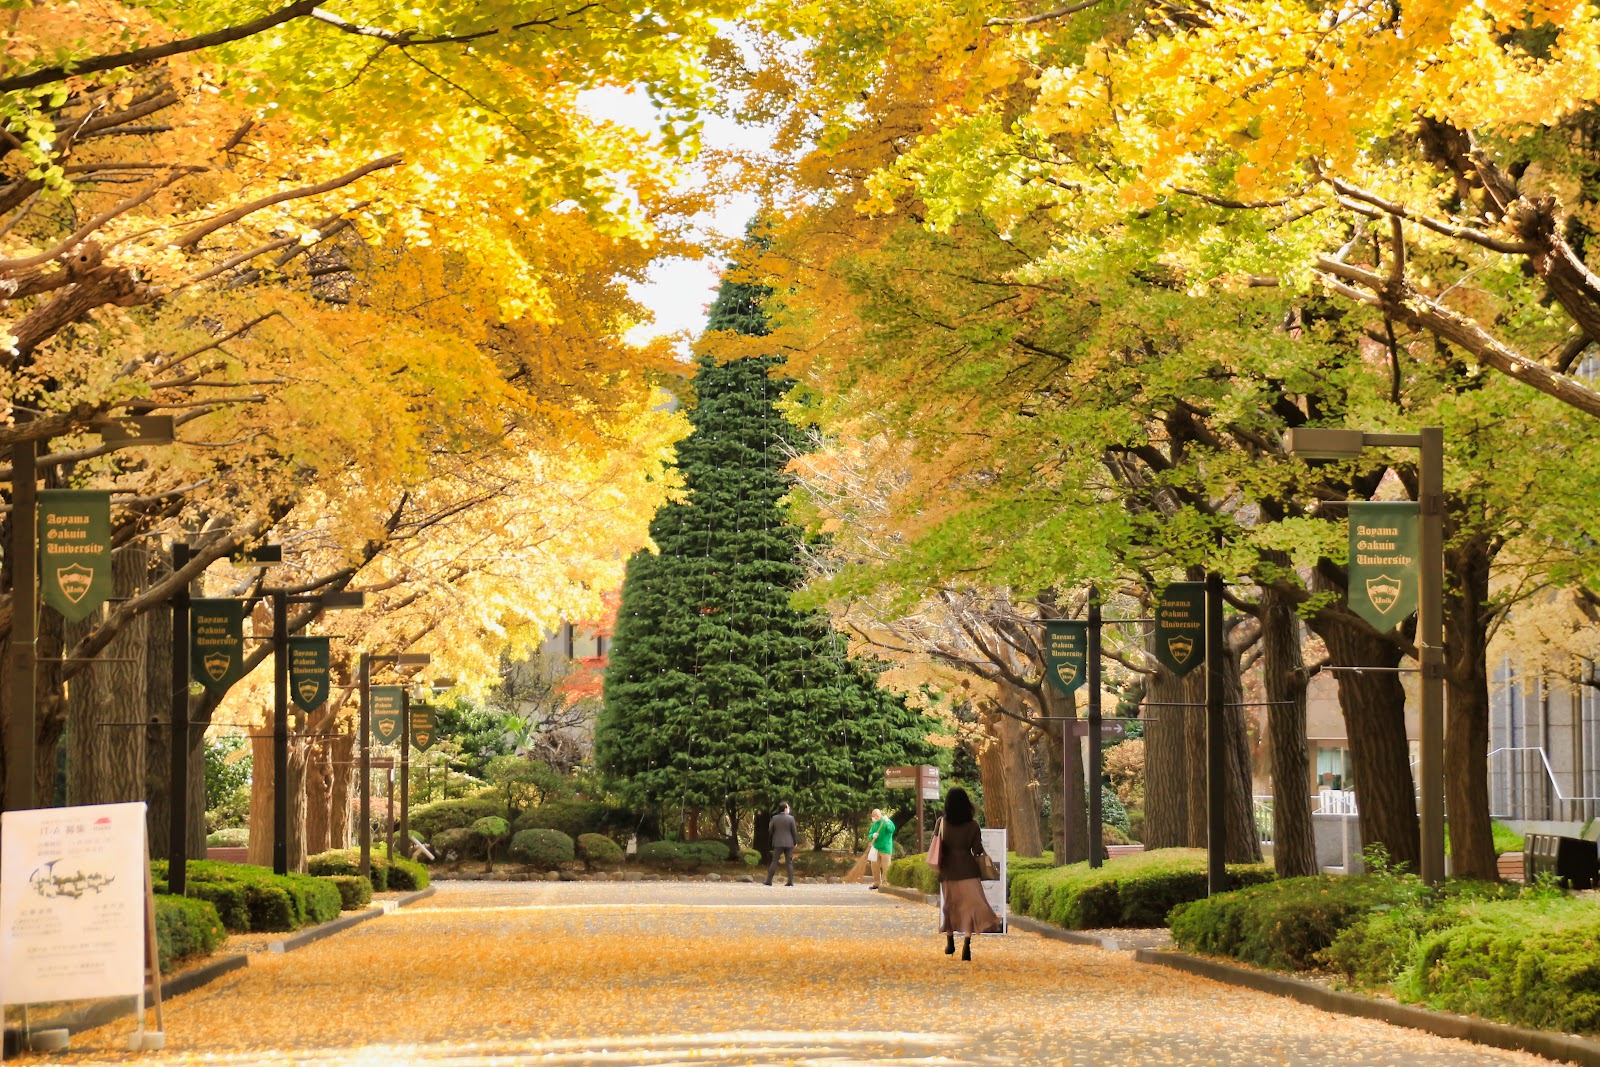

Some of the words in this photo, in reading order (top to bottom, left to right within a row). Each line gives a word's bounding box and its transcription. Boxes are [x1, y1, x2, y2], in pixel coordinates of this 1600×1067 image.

[47, 514, 90, 526] Aoyama
[47, 528, 87, 539] Gakuin
[1356, 525, 1398, 537] Aoyama
[47, 543, 104, 555] University
[1356, 540, 1396, 550] Gakuin
[1356, 555, 1411, 566] University
